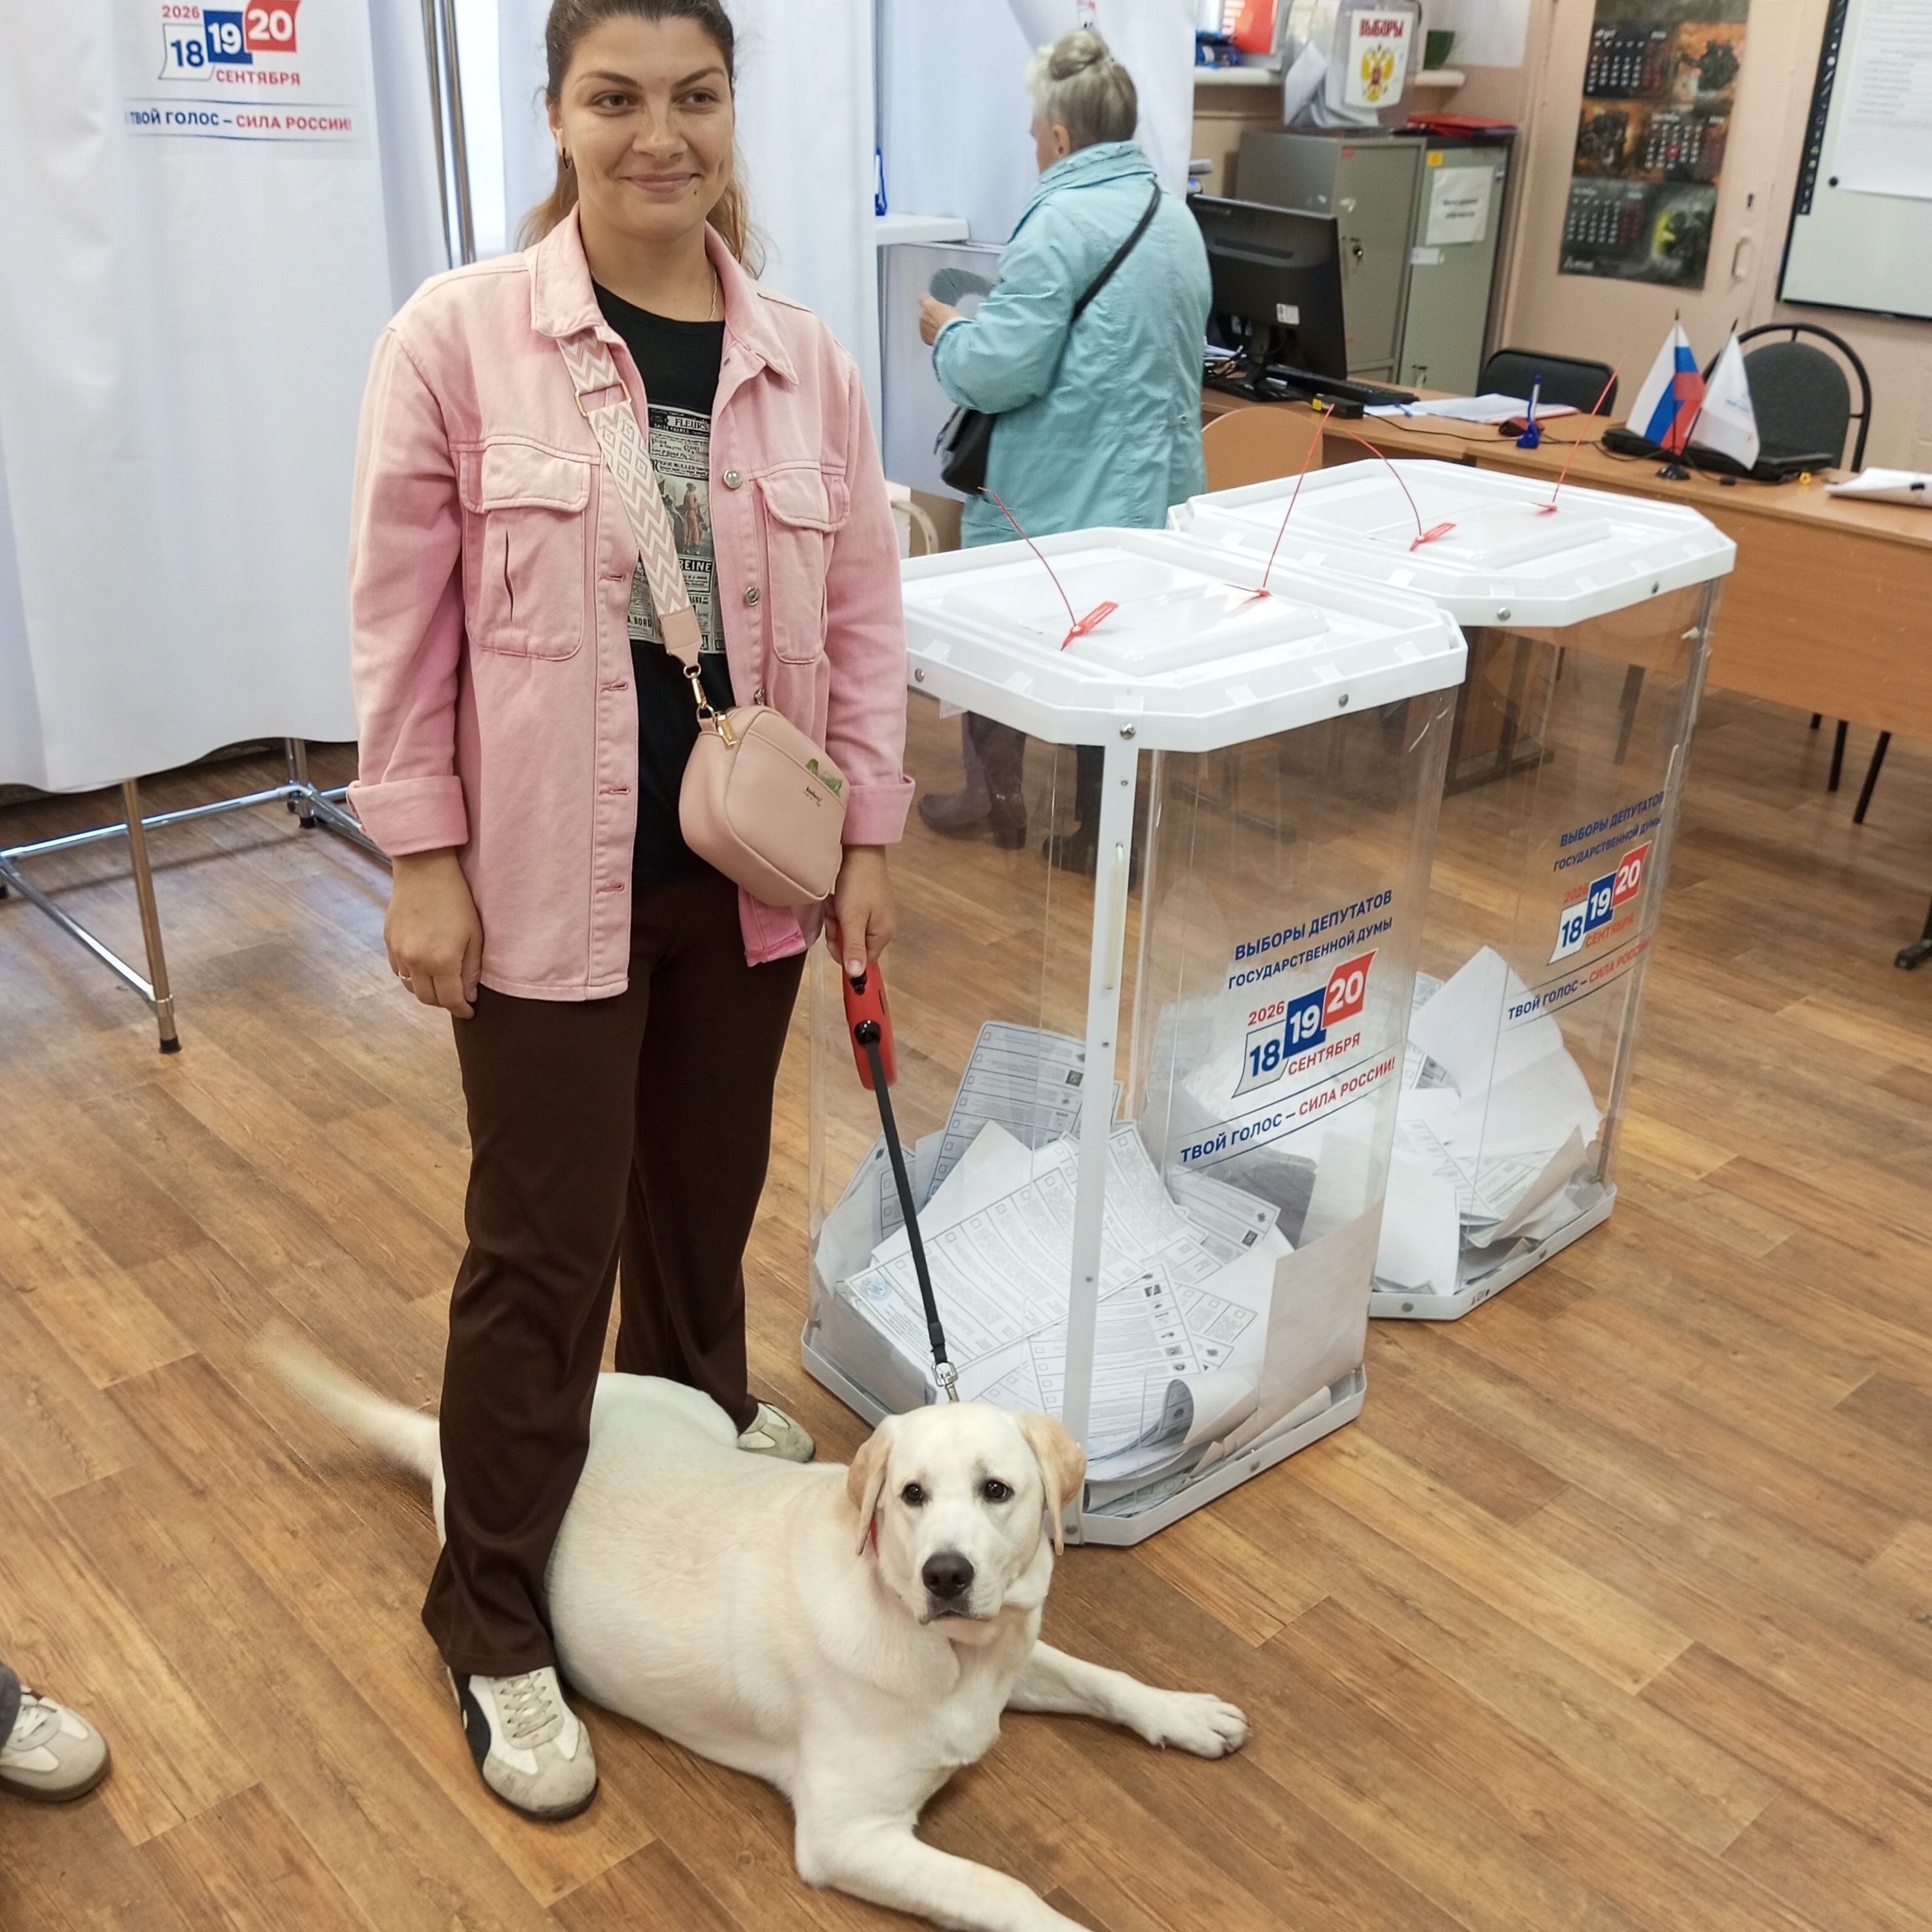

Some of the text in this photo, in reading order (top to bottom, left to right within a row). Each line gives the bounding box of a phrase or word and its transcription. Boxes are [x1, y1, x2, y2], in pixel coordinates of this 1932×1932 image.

[162, 6, 200, 19] 2026
[247, 8, 294, 42] 20
[1360, 18, 1404, 37] ВЫБОРЫ
[171, 39, 205, 68] 18
[207, 22, 242, 55] 19
[216, 69, 301, 86] СЕНТЯБРЯ
[166, 112, 219, 126] ГОЛОС
[236, 115, 281, 129] СИЛА
[675, 418, 708, 431] FLEURS
[1561, 817, 1609, 848] ВЫБОРЫ
[1615, 859, 1641, 896] 20
[1589, 887, 1611, 921] 19
[1234, 889, 1393, 961] ВЫБОРЫ ДЕПУТАТОВ
[1561, 915, 1584, 948] 18
[1228, 916, 1393, 990] ГОСУДАРСТВЕННОЙ ДУМЫ
[1326, 970, 1364, 1014] 20
[1508, 996, 1541, 1020] ТВОЙ
[1542, 980, 1579, 1007] ГОЛОС
[1589, 961, 1615, 984] СИЛА
[1248, 1001, 1285, 1026] 2026
[1289, 1004, 1320, 1043] 19
[1249, 1038, 1282, 1078] 18
[1288, 1032, 1361, 1076] СЕНТЯБРЯ
[1180, 1133, 1227, 1163] ТВОЙ
[1230, 1112, 1282, 1146] ГОЛОС
[1299, 1087, 1337, 1116] СИЛА
[1340, 1056, 1396, 1097] РОССИИ!
